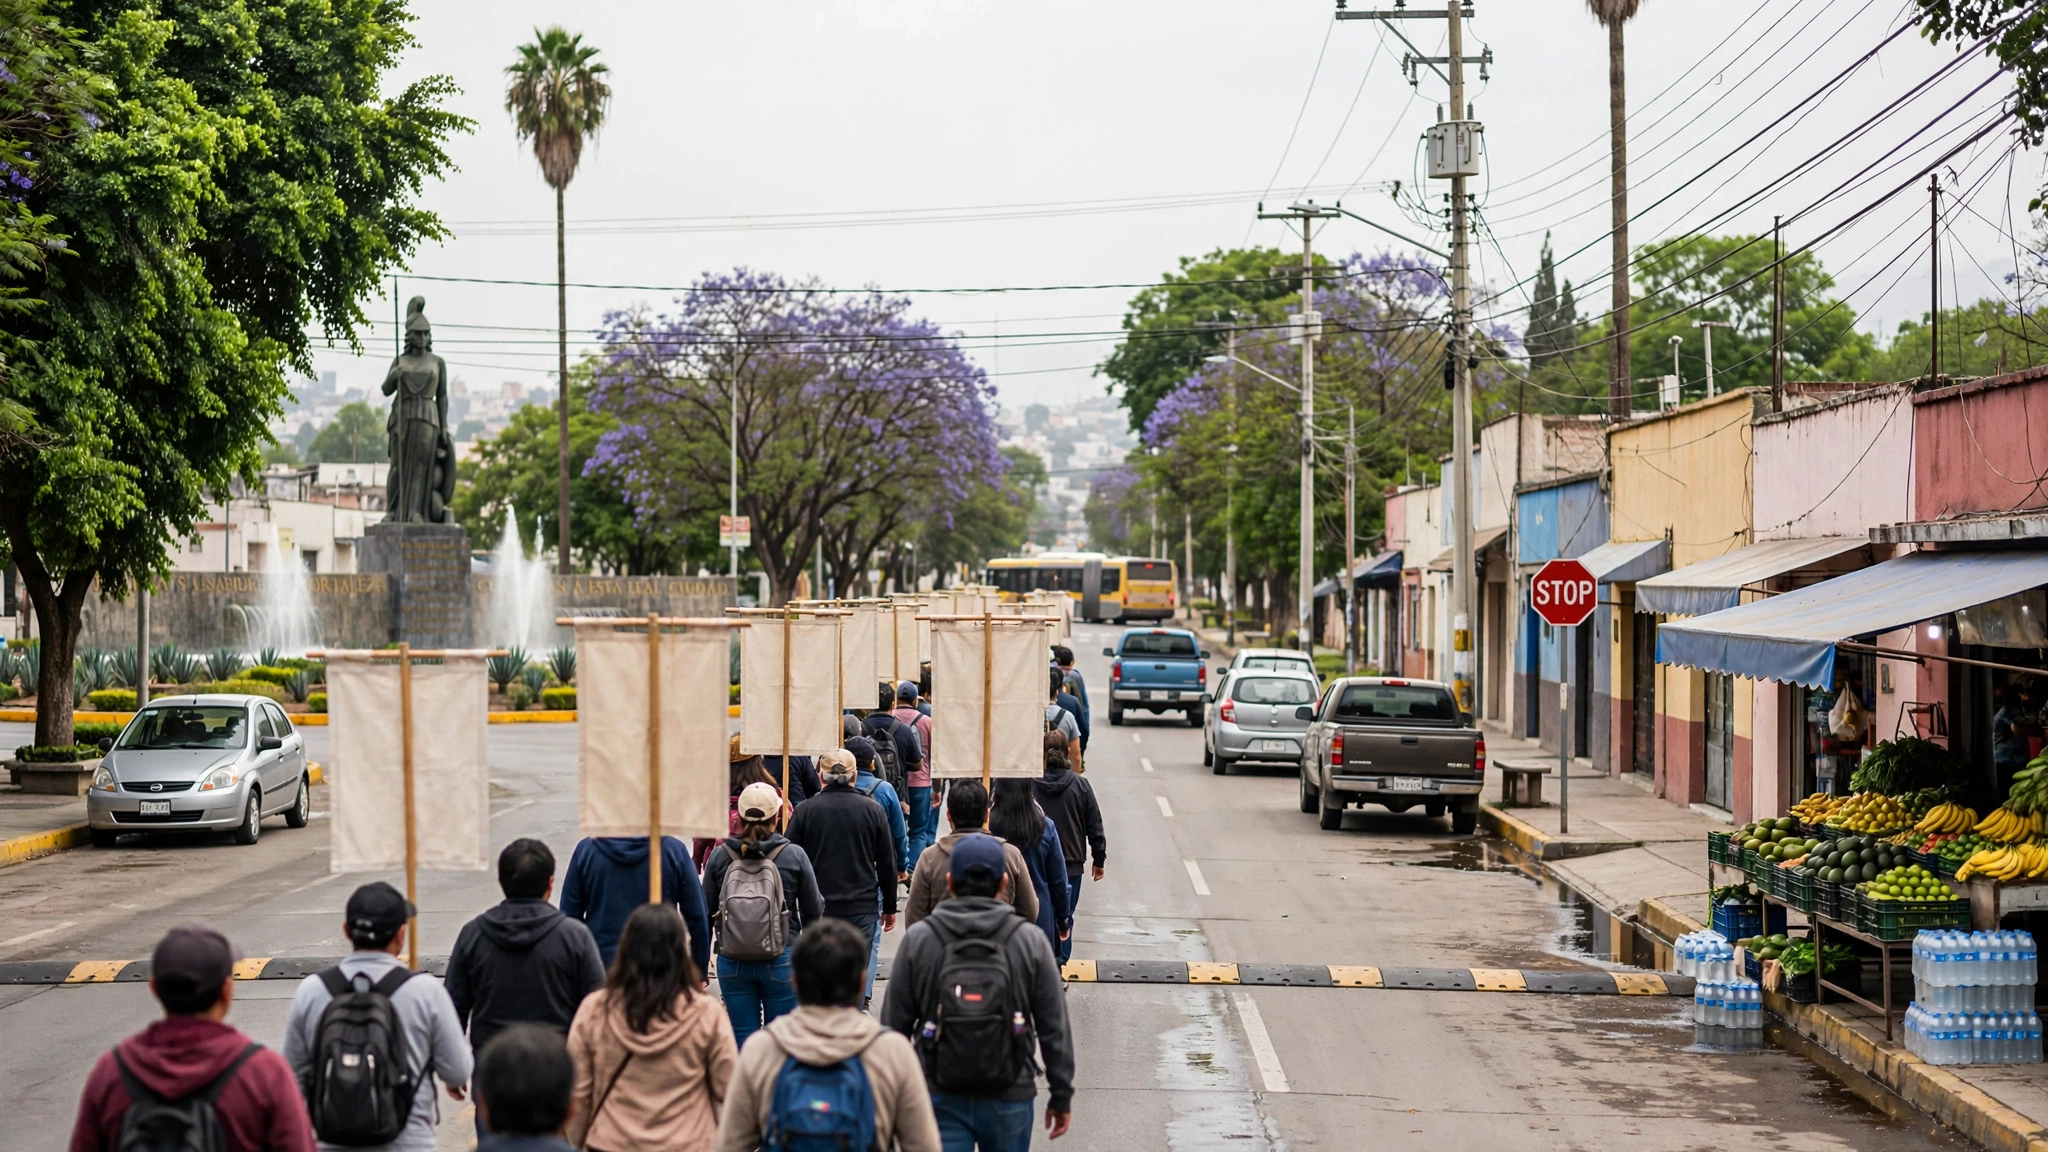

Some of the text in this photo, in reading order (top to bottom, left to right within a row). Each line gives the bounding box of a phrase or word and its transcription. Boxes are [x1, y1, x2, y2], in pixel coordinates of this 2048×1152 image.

[588, 579, 622, 595] ESTA
[668, 581, 729, 596] CIUDAD
[1536, 580, 1593, 605] STOP
